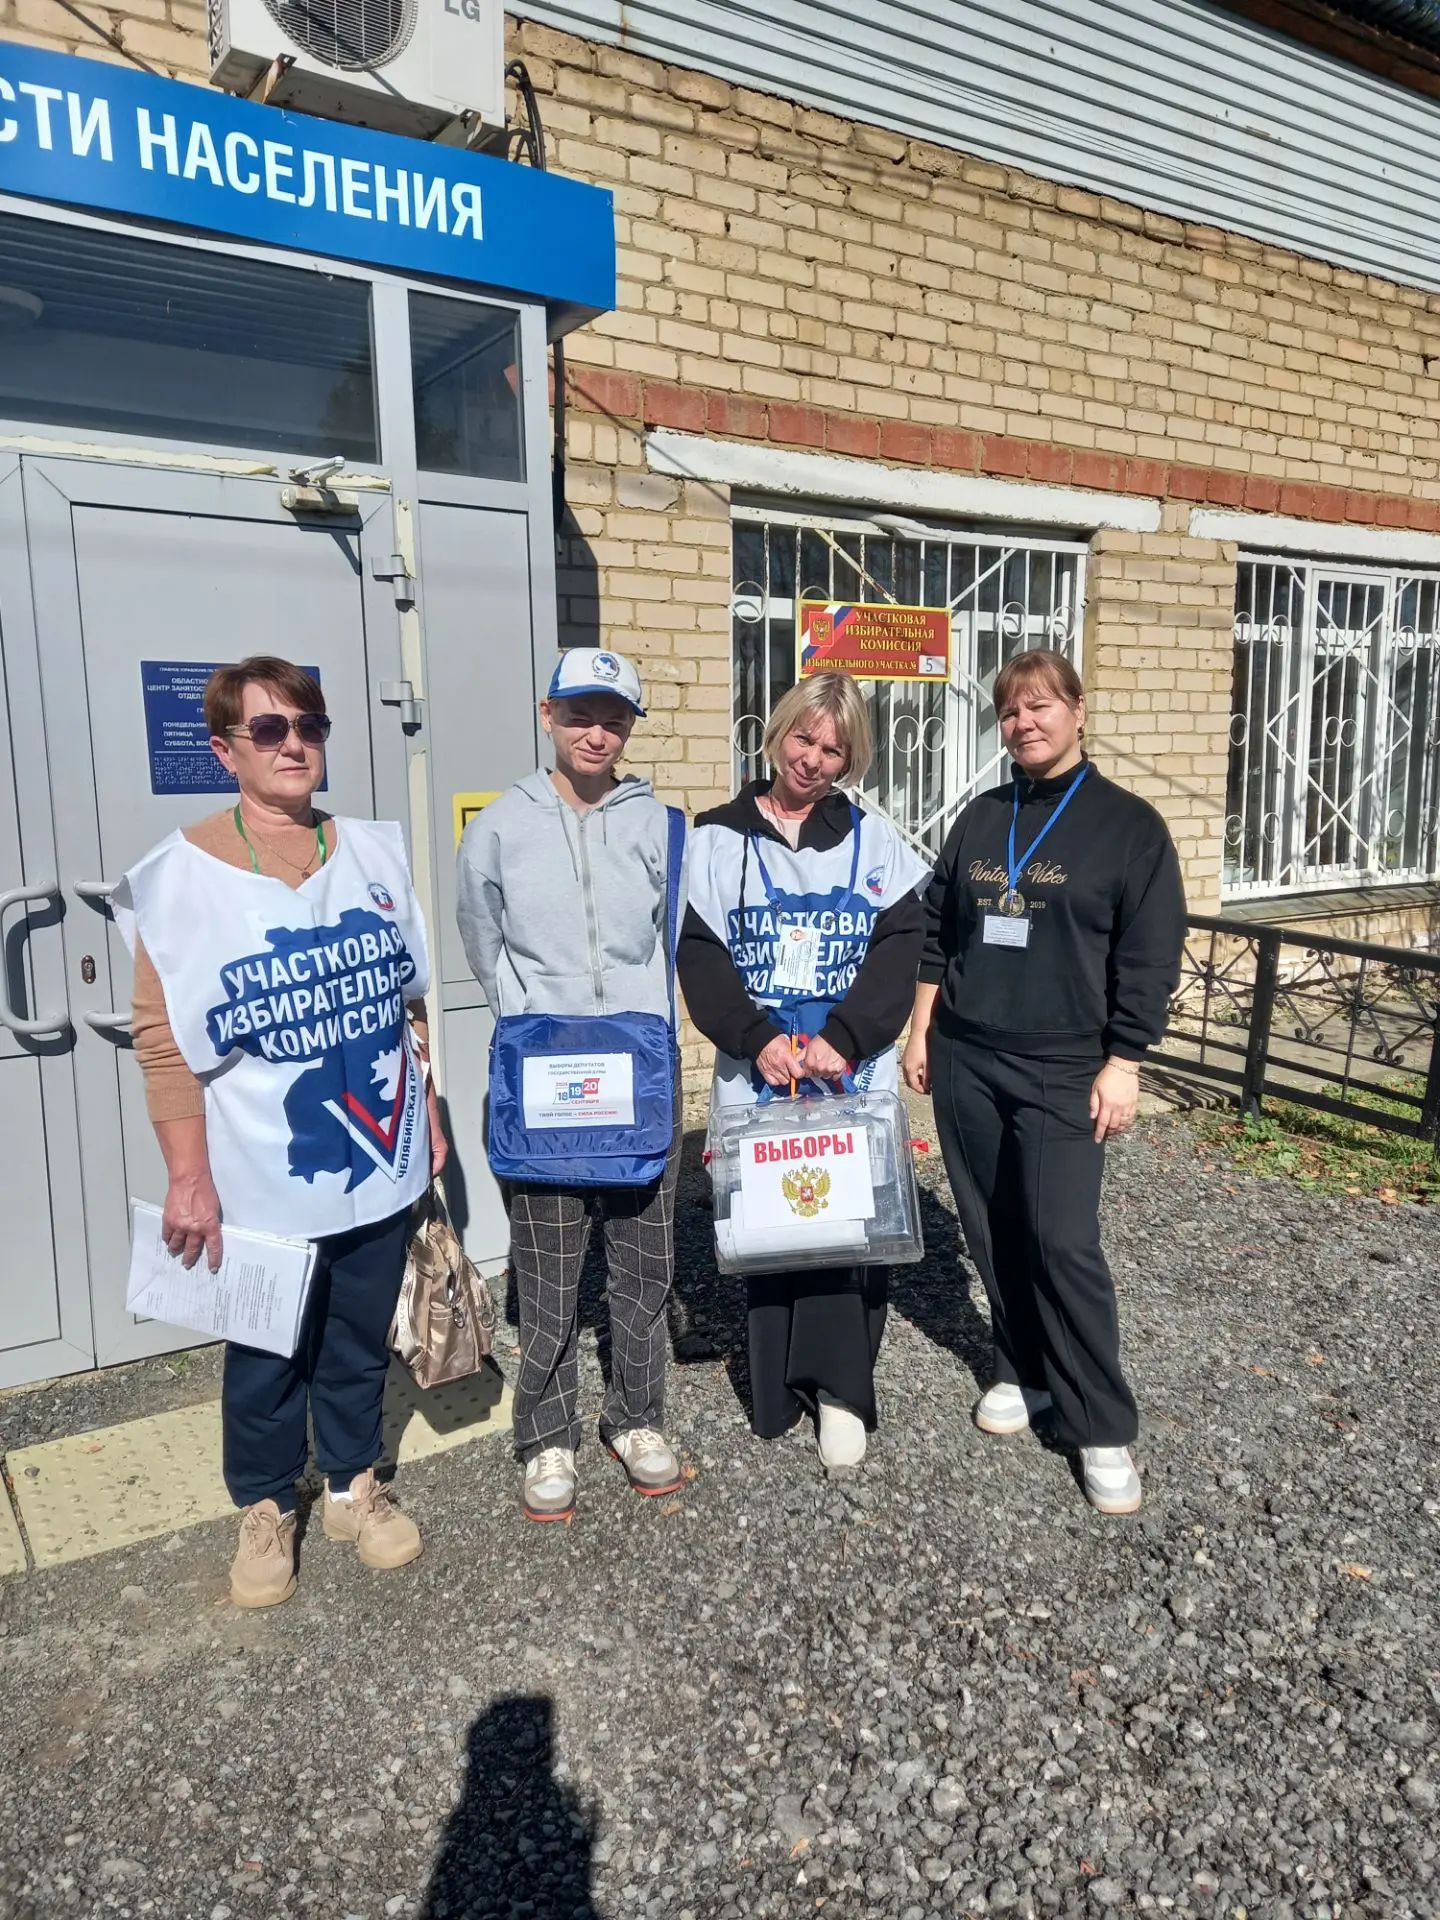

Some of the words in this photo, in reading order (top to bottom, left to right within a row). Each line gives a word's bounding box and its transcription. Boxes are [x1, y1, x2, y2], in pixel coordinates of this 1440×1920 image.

[444, 0, 480, 22] LG
[136, 107, 484, 241] НАСЕЛЕНИЯ
[855, 611, 926, 625] УЧАСТКОВАЯ
[845, 624, 935, 639] ИЗБИРАТЕЛЬНАЯ
[860, 639, 922, 652] КОМИССИЯ
[805, 657, 874, 669] ИЗБИРАТЕЛЬНОГО
[875, 660, 908, 670] УЧАСТКА
[925, 657, 934, 673] 5
[147, 684, 170, 692] ЦЕНТР
[171, 684, 206, 693] ЗАНЯТОС
[171, 677, 209, 685] ОБЛАСТНО
[177, 692, 201, 700] ОТДЕЛ
[163, 730, 194, 738] ПЯТНИЦА
[1027, 860, 1069, 885] Vibes
[977, 898, 992, 906] EST
[224, 926, 403, 1000] УЧАСТКОВАЯ
[259, 992, 401, 1060] КОМИССИЯ
[557, 1091, 568, 1101] 18
[570, 1086, 581, 1096] 19
[583, 1081, 597, 1091] 20
[398, 1085, 417, 1178] ЧЕЛЯБИНСКАЯ
[753, 1132, 855, 1164] ВЫБОРЫ
